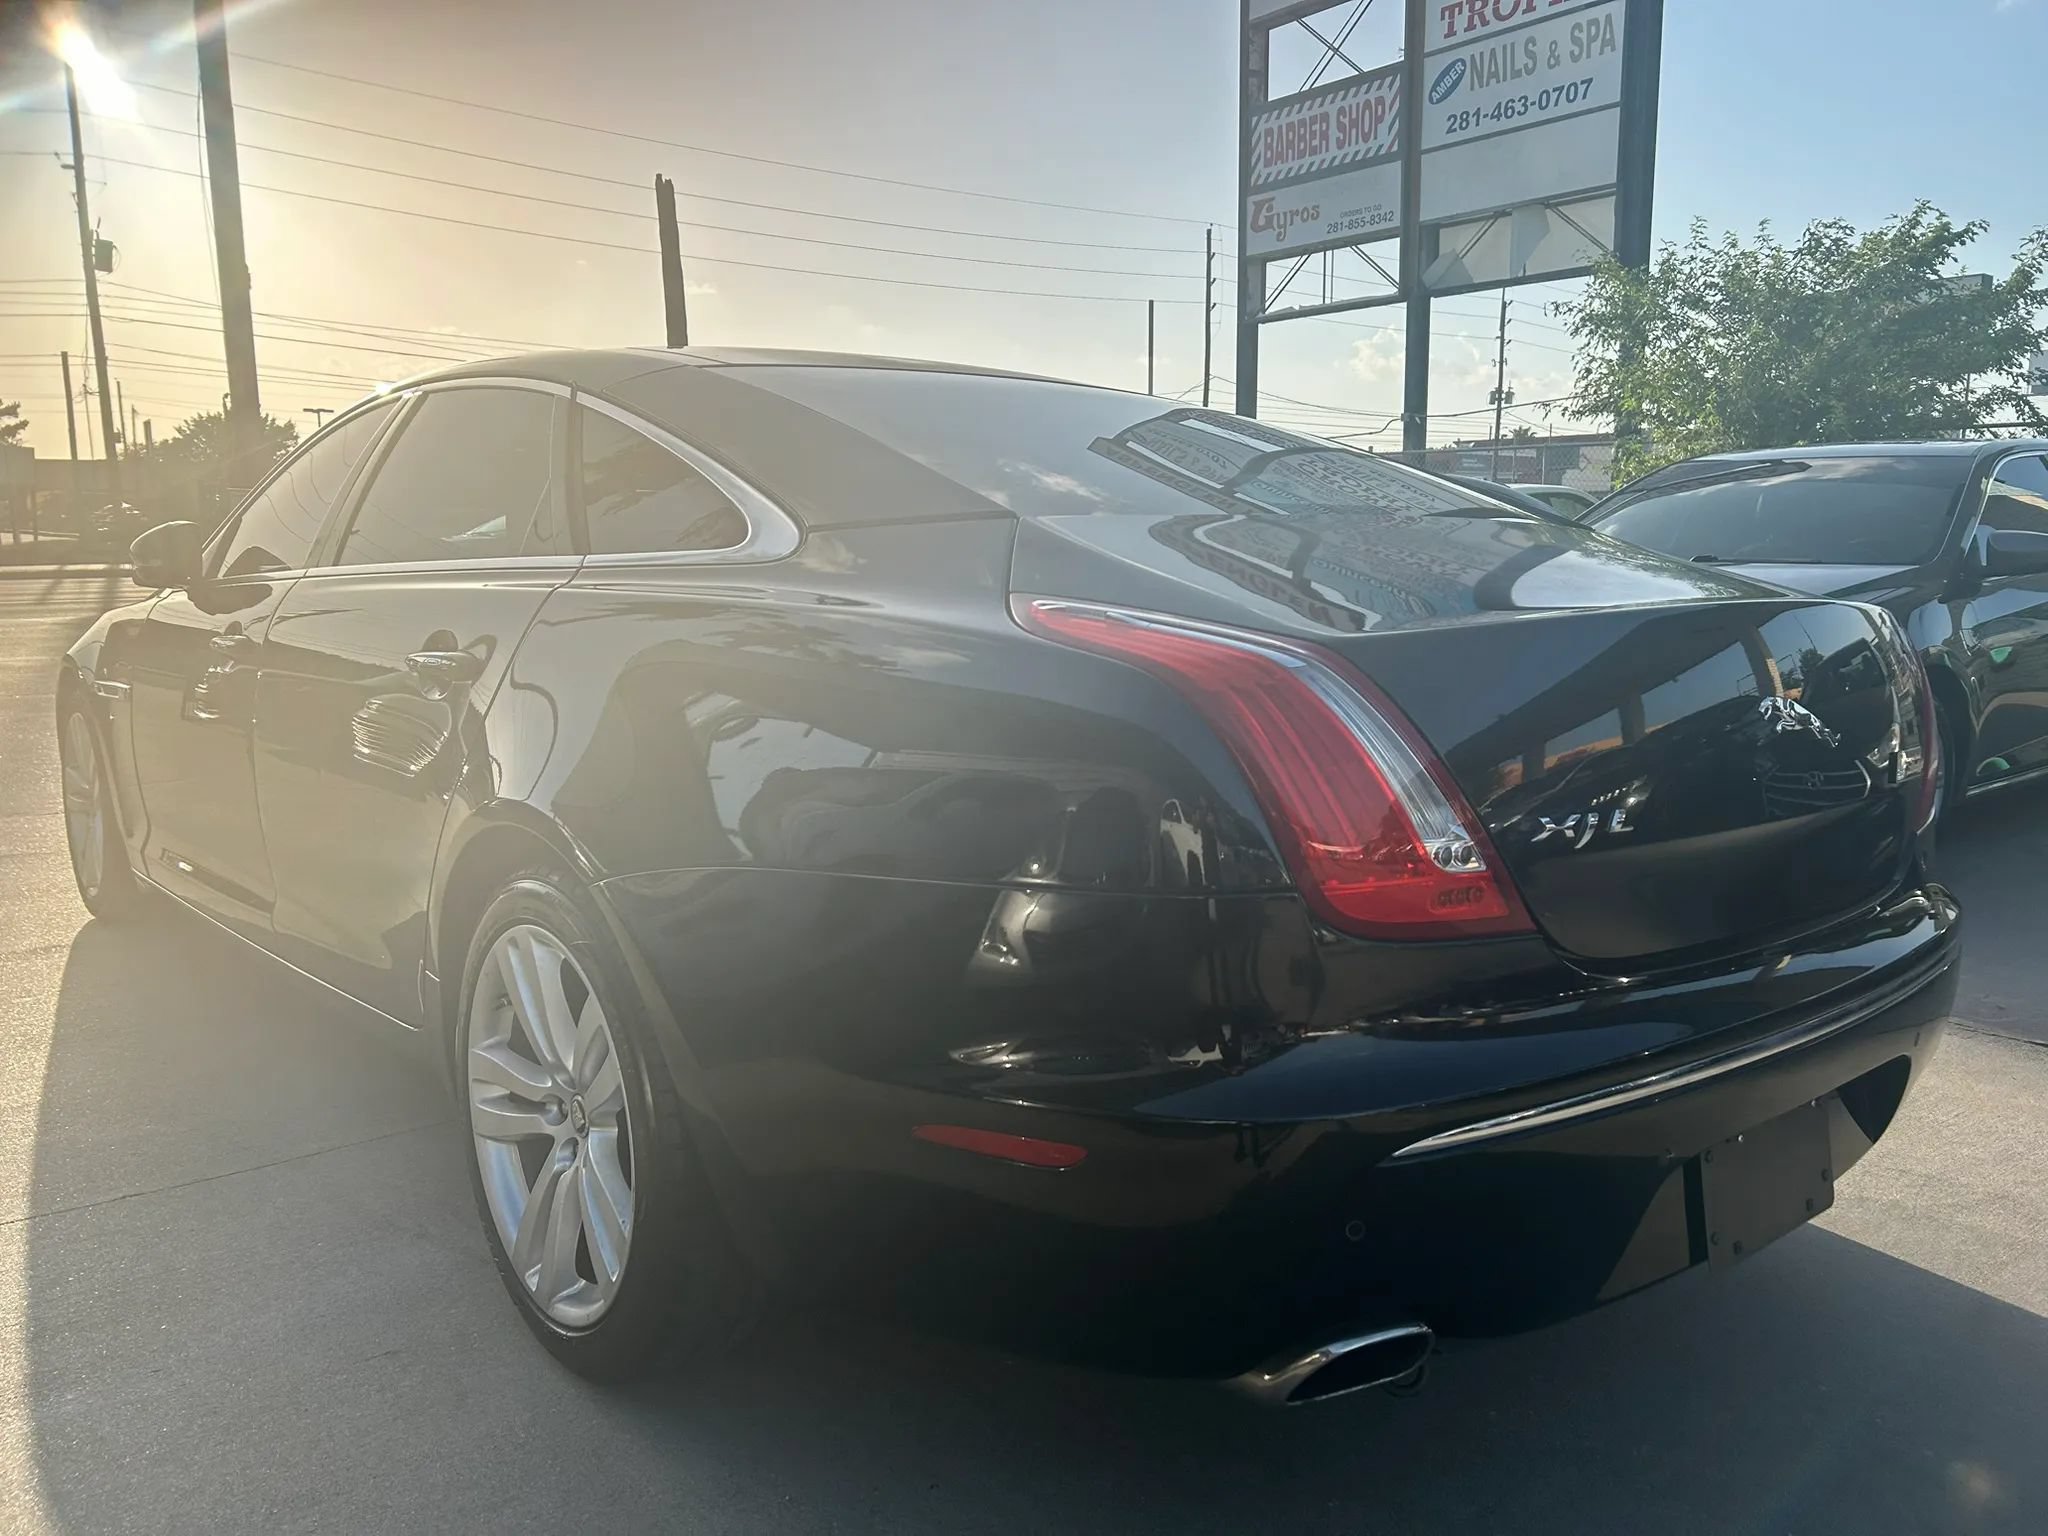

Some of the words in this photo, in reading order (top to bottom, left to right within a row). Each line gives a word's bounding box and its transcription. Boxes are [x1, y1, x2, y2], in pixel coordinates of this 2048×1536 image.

[1469, 35, 1538, 91] NAILS
[1546, 39, 1561, 70] &
[1569, 13, 1617, 64] SPA
[1430, 61, 1465, 104] AMBER
[1445, 77, 1594, 135] 281-463-0707
[1263, 111, 1330, 169] BARBER
[1335, 95, 1386, 150] SHOP
[1250, 196, 1321, 242] Gyros
[1326, 210, 1394, 234] 281-855-8342
[1531, 808, 1634, 849] XJL
